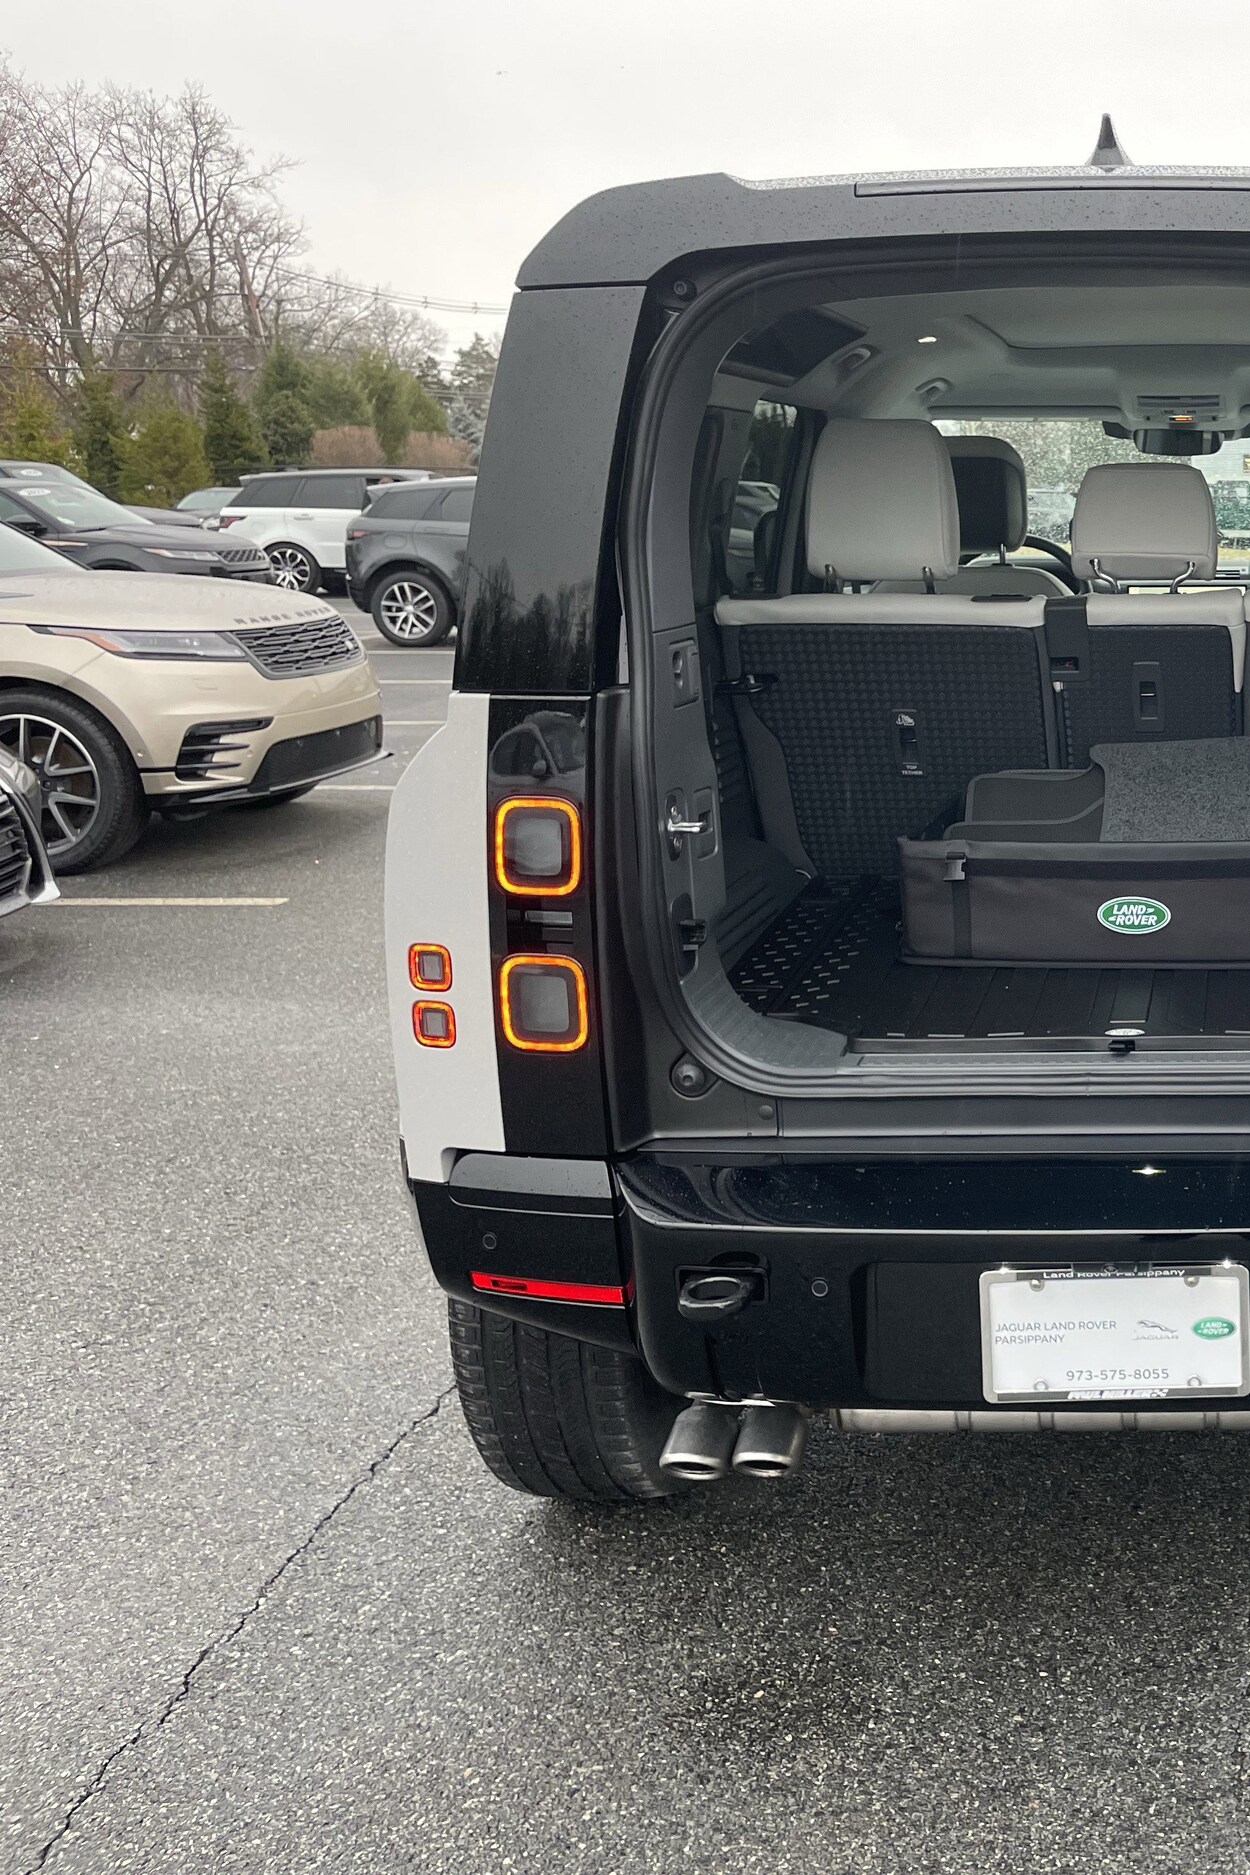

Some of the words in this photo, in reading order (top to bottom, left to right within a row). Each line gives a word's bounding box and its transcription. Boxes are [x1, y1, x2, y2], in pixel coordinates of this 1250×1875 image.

[1112, 904, 1147, 915] LAND
[1115, 915, 1158, 926] ROVER
[995, 1322, 1041, 1333] JAGUAR
[1044, 1321, 1076, 1331] LAND
[1078, 1320, 1117, 1330] ROVER
[995, 1334, 1066, 1345] PARSIPPANY
[1066, 1368, 1169, 1381] 973-575-8055
